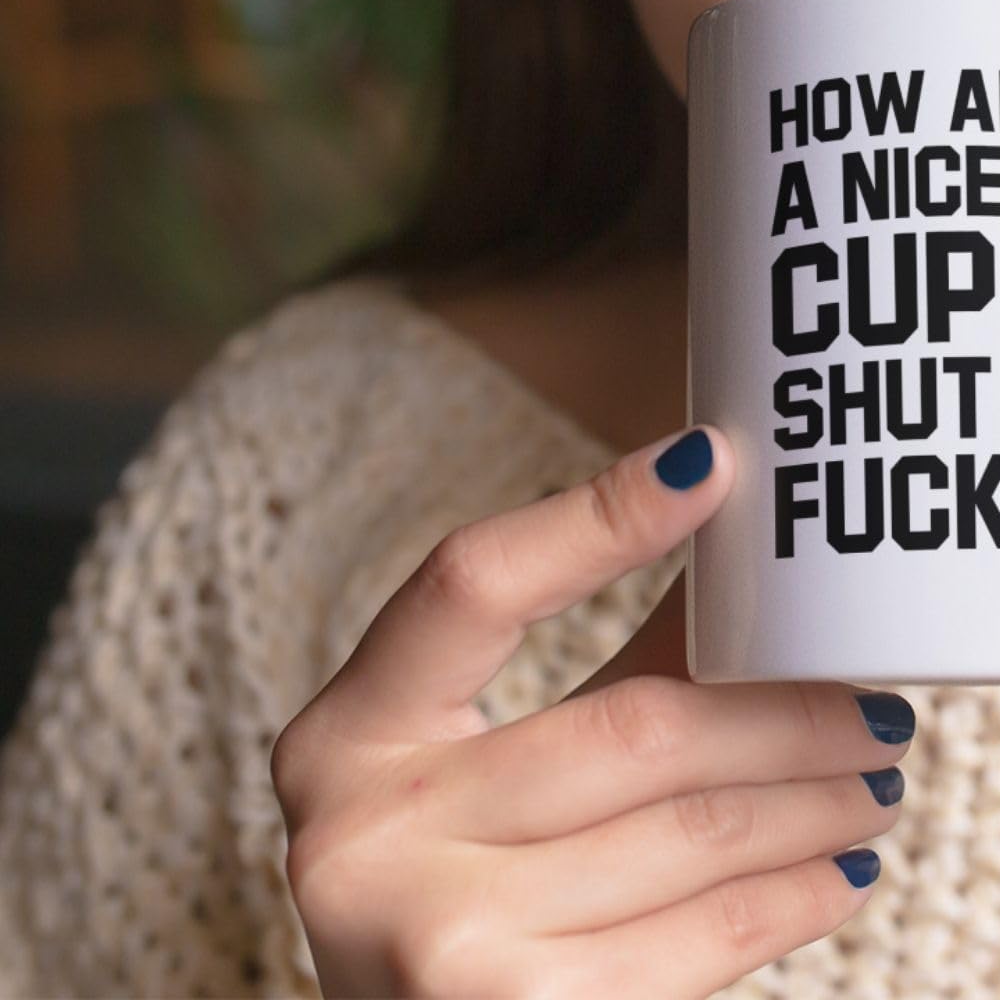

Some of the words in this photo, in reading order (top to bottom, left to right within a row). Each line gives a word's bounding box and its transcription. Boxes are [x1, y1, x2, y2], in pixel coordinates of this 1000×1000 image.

[769, 70, 925, 153] HOW
[772, 160, 819, 235] A
[770, 230, 996, 357] CUP
[773, 356, 992, 453] SHUT
